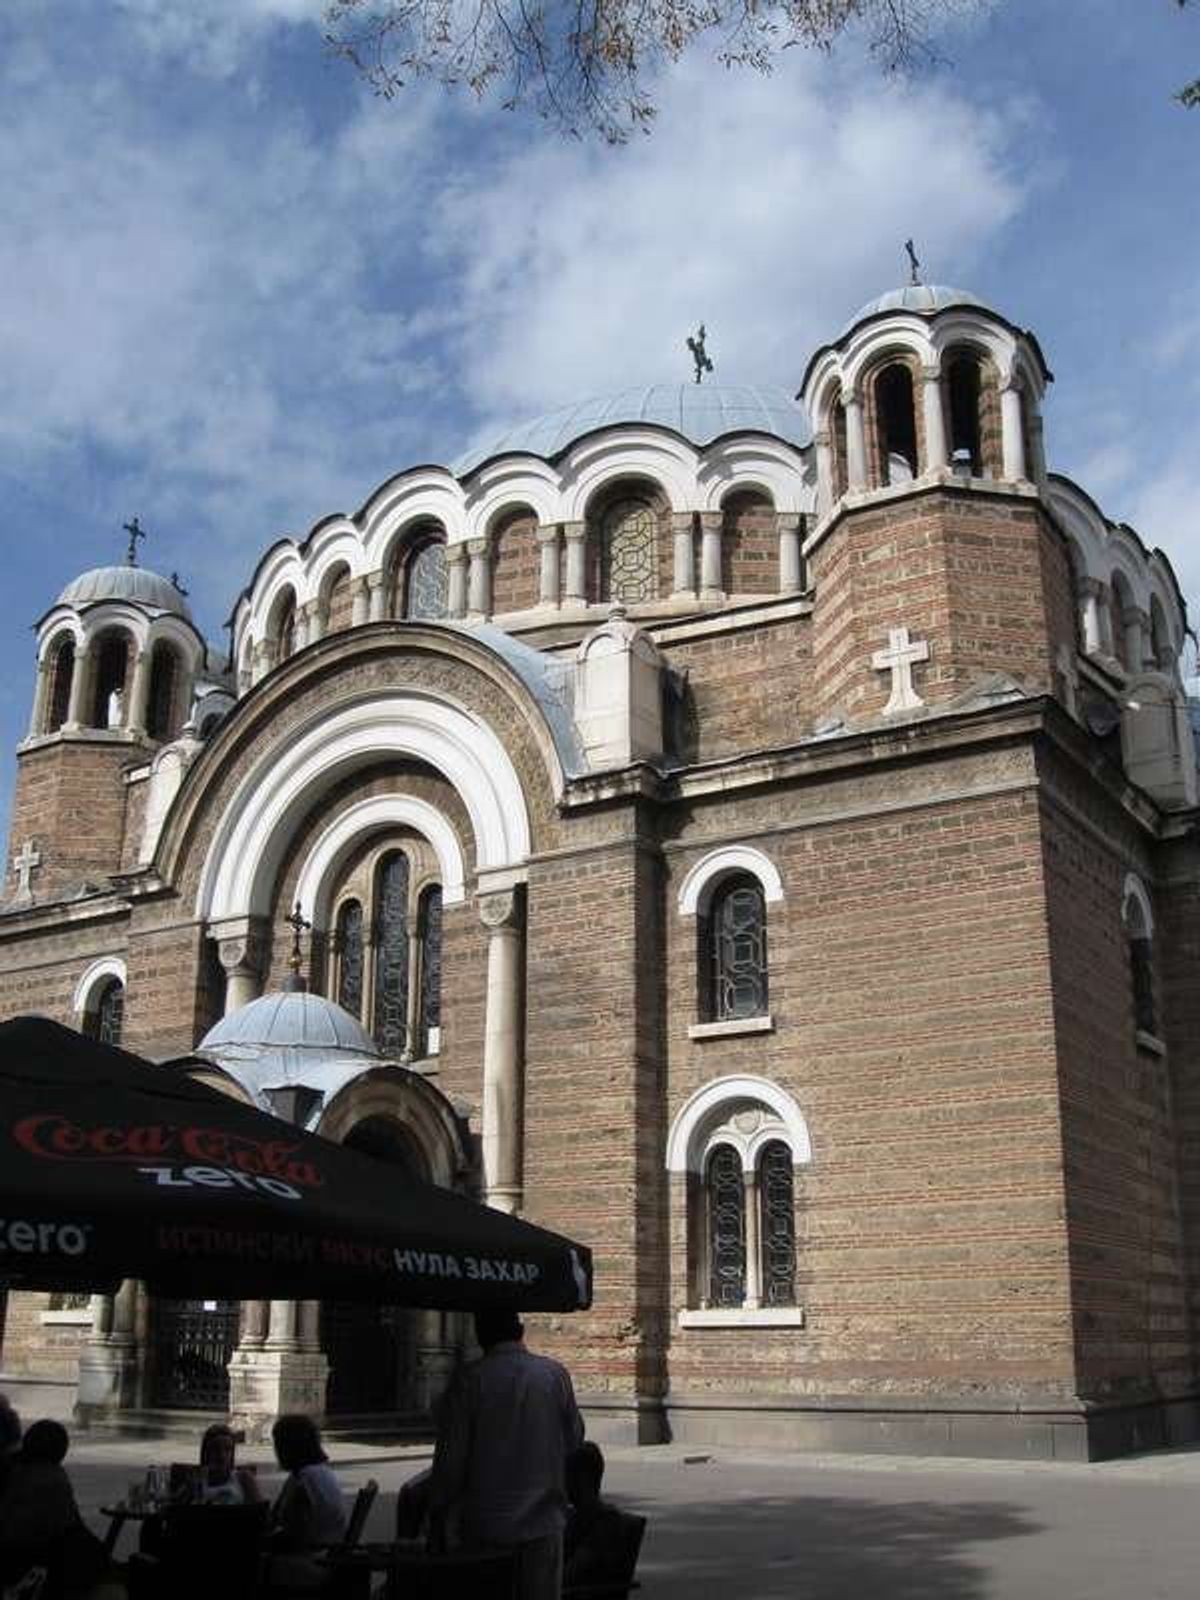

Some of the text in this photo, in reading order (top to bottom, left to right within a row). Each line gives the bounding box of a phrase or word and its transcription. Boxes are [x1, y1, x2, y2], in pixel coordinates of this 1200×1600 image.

[135, 1165, 303, 1199] zero
[393, 1247, 462, 1279] НУЛА
[463, 1255, 540, 1285] ЗАХАР
